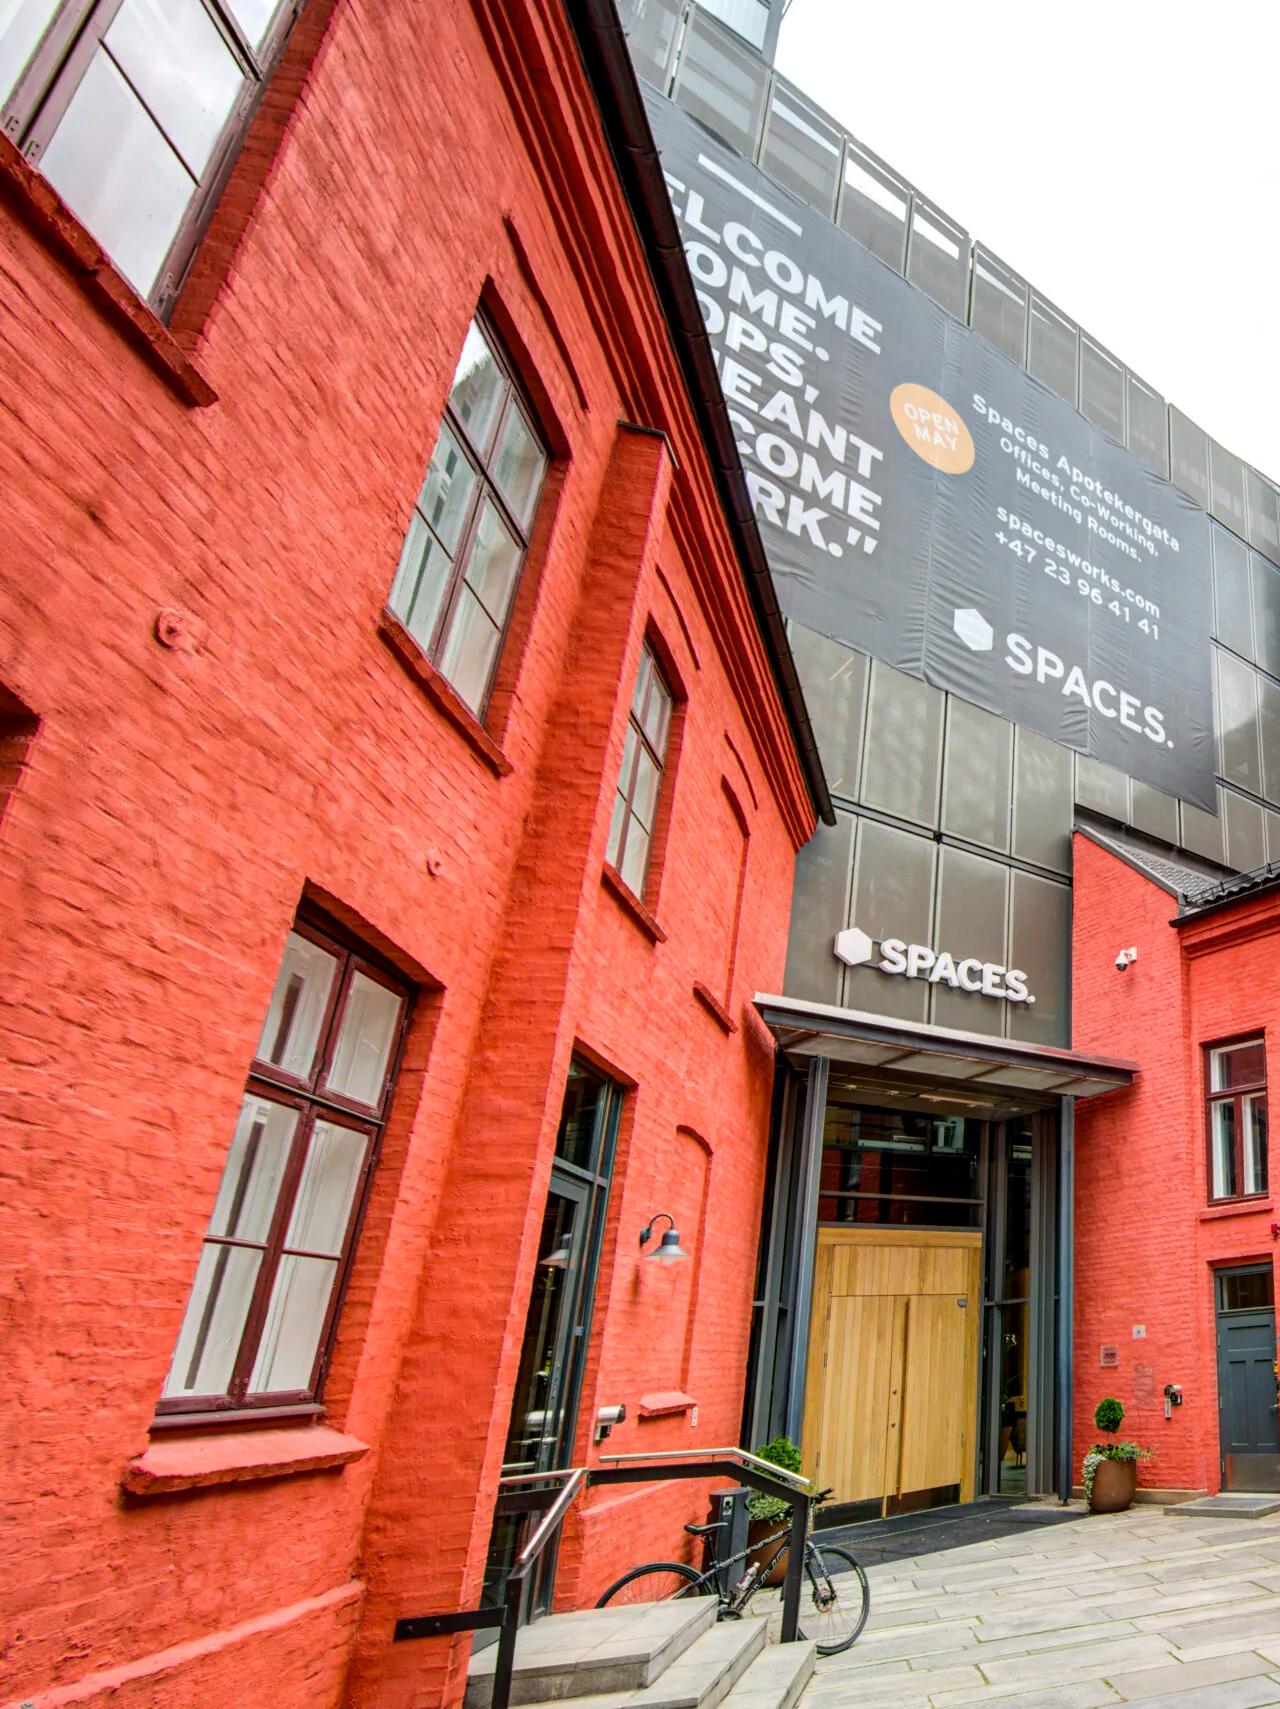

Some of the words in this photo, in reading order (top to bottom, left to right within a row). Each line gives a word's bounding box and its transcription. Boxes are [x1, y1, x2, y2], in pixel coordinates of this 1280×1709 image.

[904, 402, 960, 436] OPEN
[913, 423, 957, 451] MAY
[972, 394, 1049, 460] Spaces
[1056, 455, 1180, 552] Apotekergata
[1000, 437, 1064, 492] Offices,
[1070, 485, 1159, 557] Co-Working,
[1016, 467, 1082, 525] Meeting
[1088, 515, 1142, 562] Rooms.
[995, 531, 1037, 563] +47
[1044, 558, 1071, 586] 23
[1077, 578, 1103, 604] 96
[1108, 600, 1130, 622] 41
[1138, 618, 1159, 640] 41
[997, 506, 1160, 619] spacesworks.com
[1004, 633, 1174, 749] SPACES.
[879, 938, 1036, 1005] SPACES.
